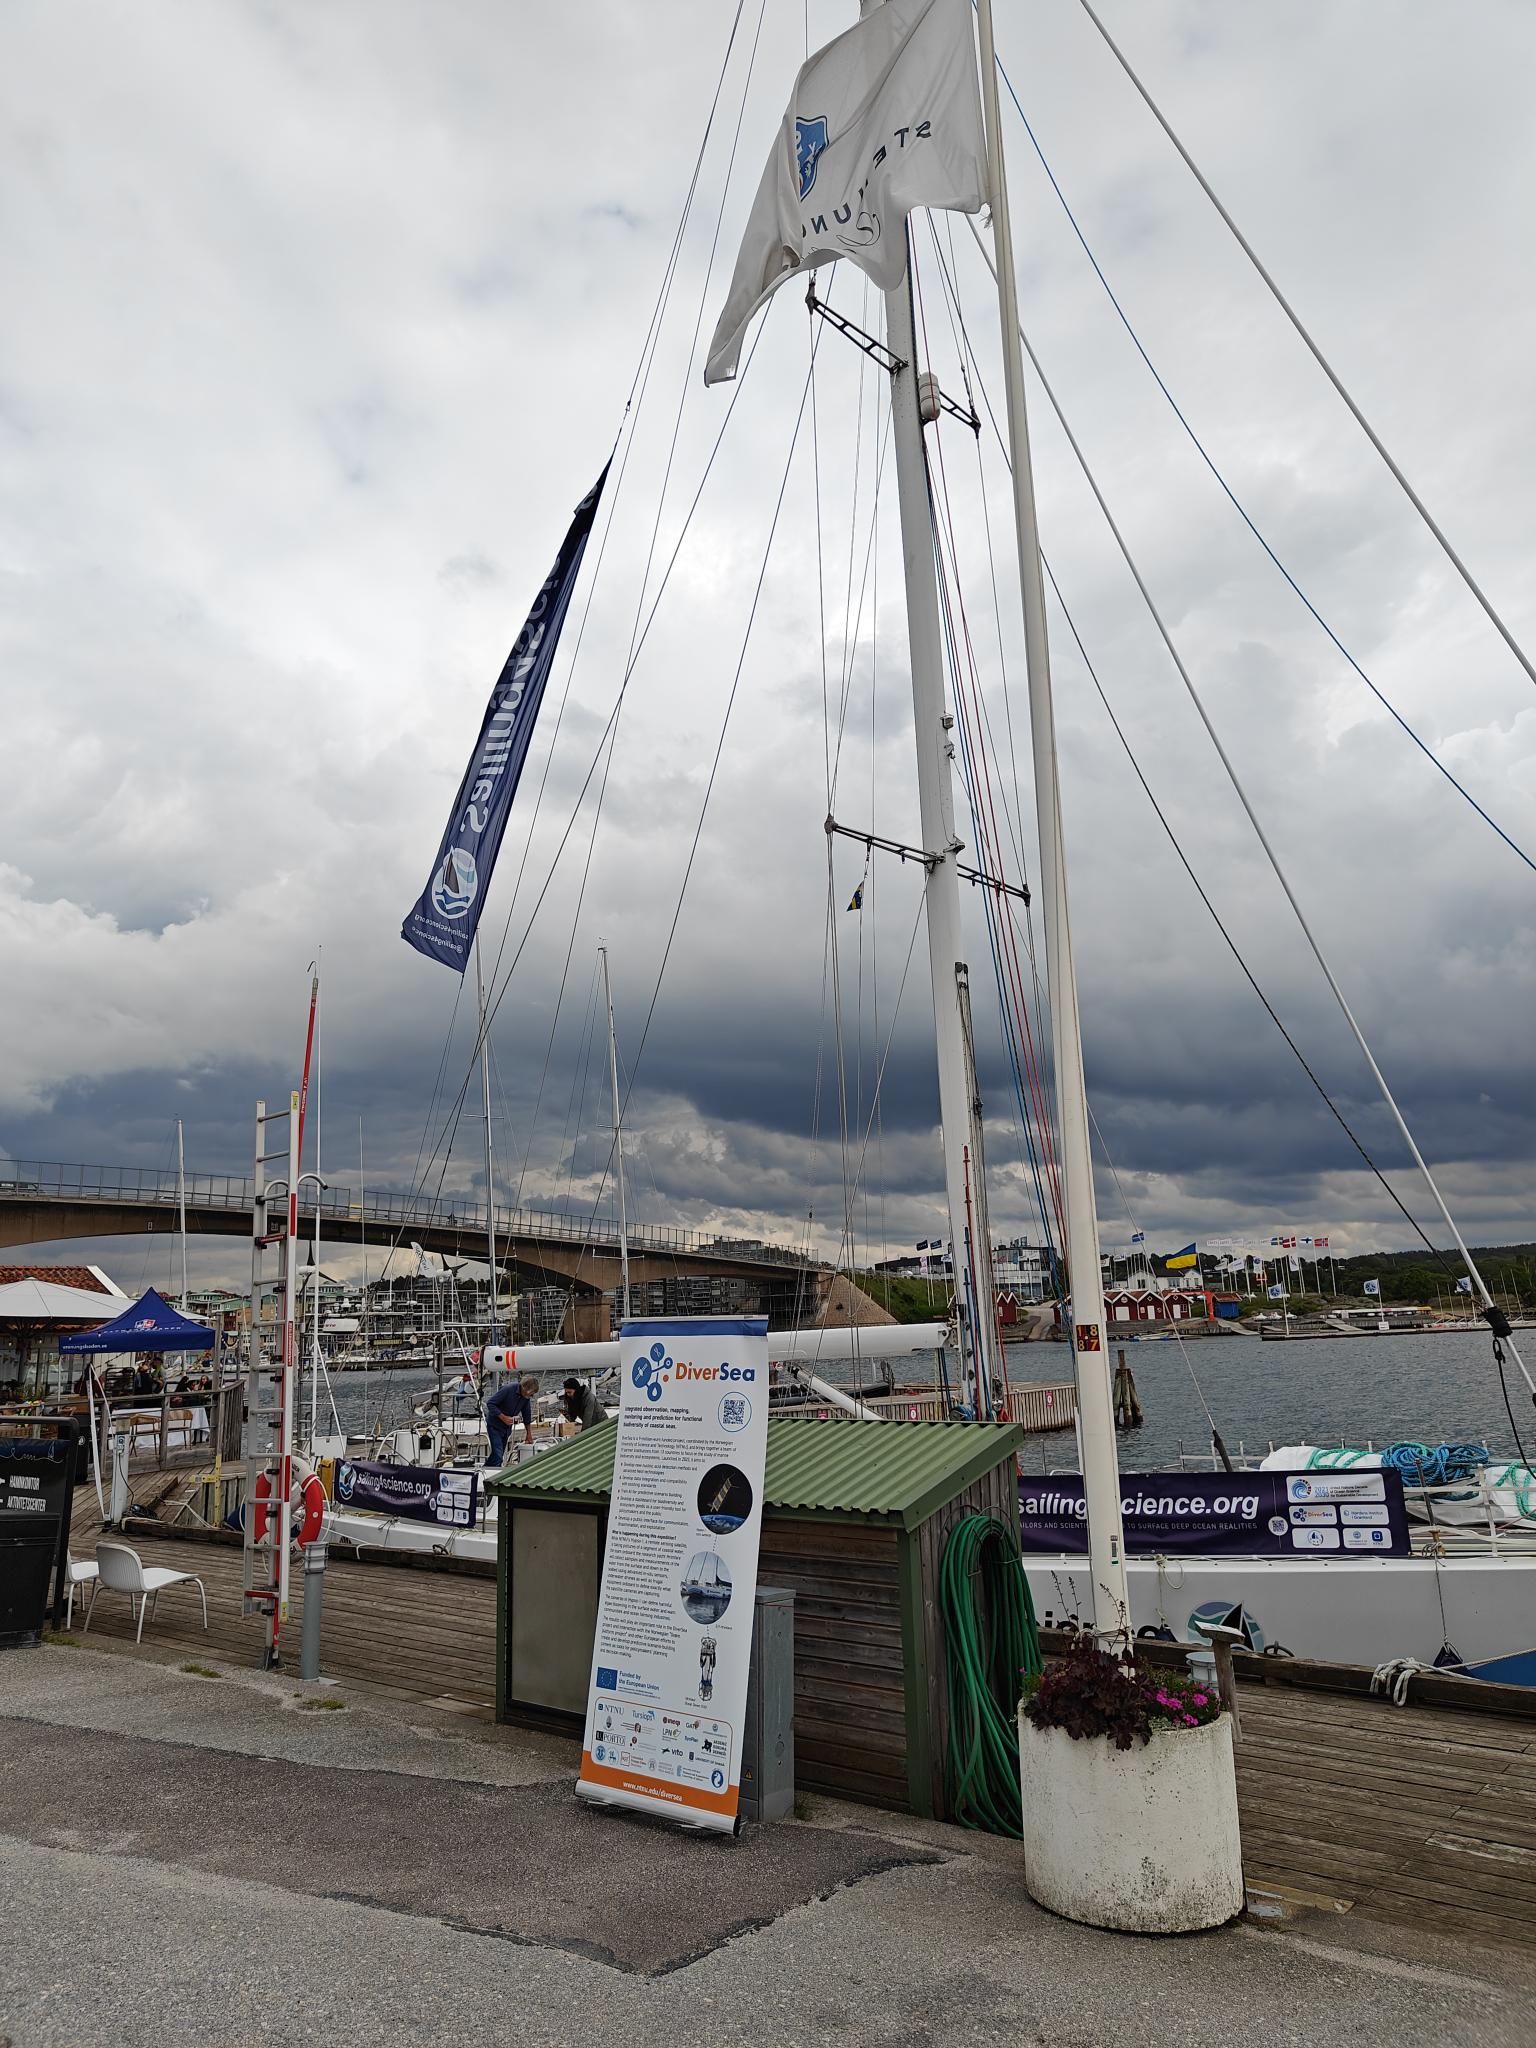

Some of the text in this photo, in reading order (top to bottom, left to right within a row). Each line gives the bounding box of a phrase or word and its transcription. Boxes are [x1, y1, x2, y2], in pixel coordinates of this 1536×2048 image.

[675, 1362, 756, 1382] DiverSea
[356, 1472, 432, 1499] sailing4science.org
[626, 1679, 645, 1689] European
[604, 1704, 624, 1716] NTNU
[672, 1748, 683, 1757] vito
[623, 1781, 682, 1802] www.ntnu.edu/diversea
